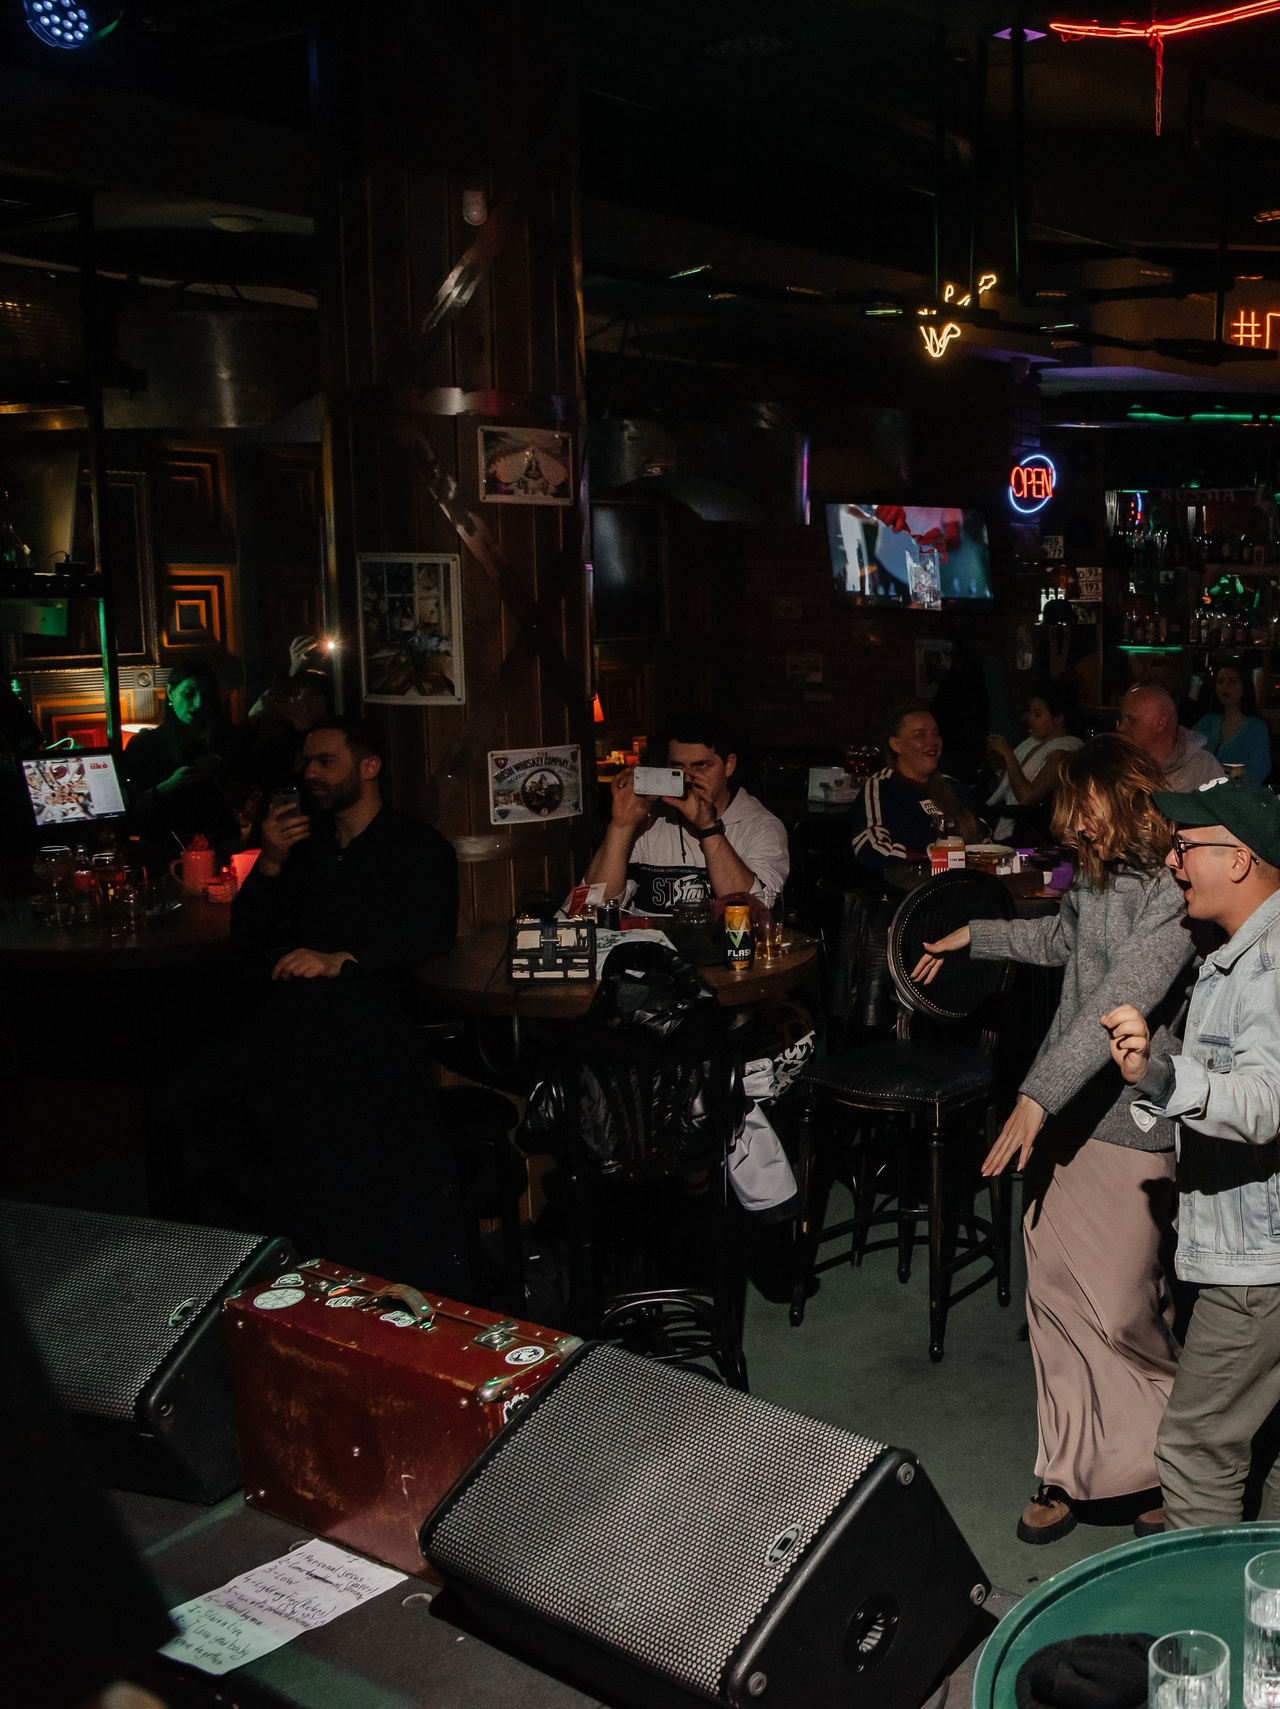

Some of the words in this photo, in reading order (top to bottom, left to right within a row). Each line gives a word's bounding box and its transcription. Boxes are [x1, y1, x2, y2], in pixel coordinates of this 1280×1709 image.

[1010, 466, 1052, 499] OPEN
[493, 766, 515, 784] IRISH
[513, 756, 545, 772] WHISKEY
[544, 756, 570, 769] COMPANY
